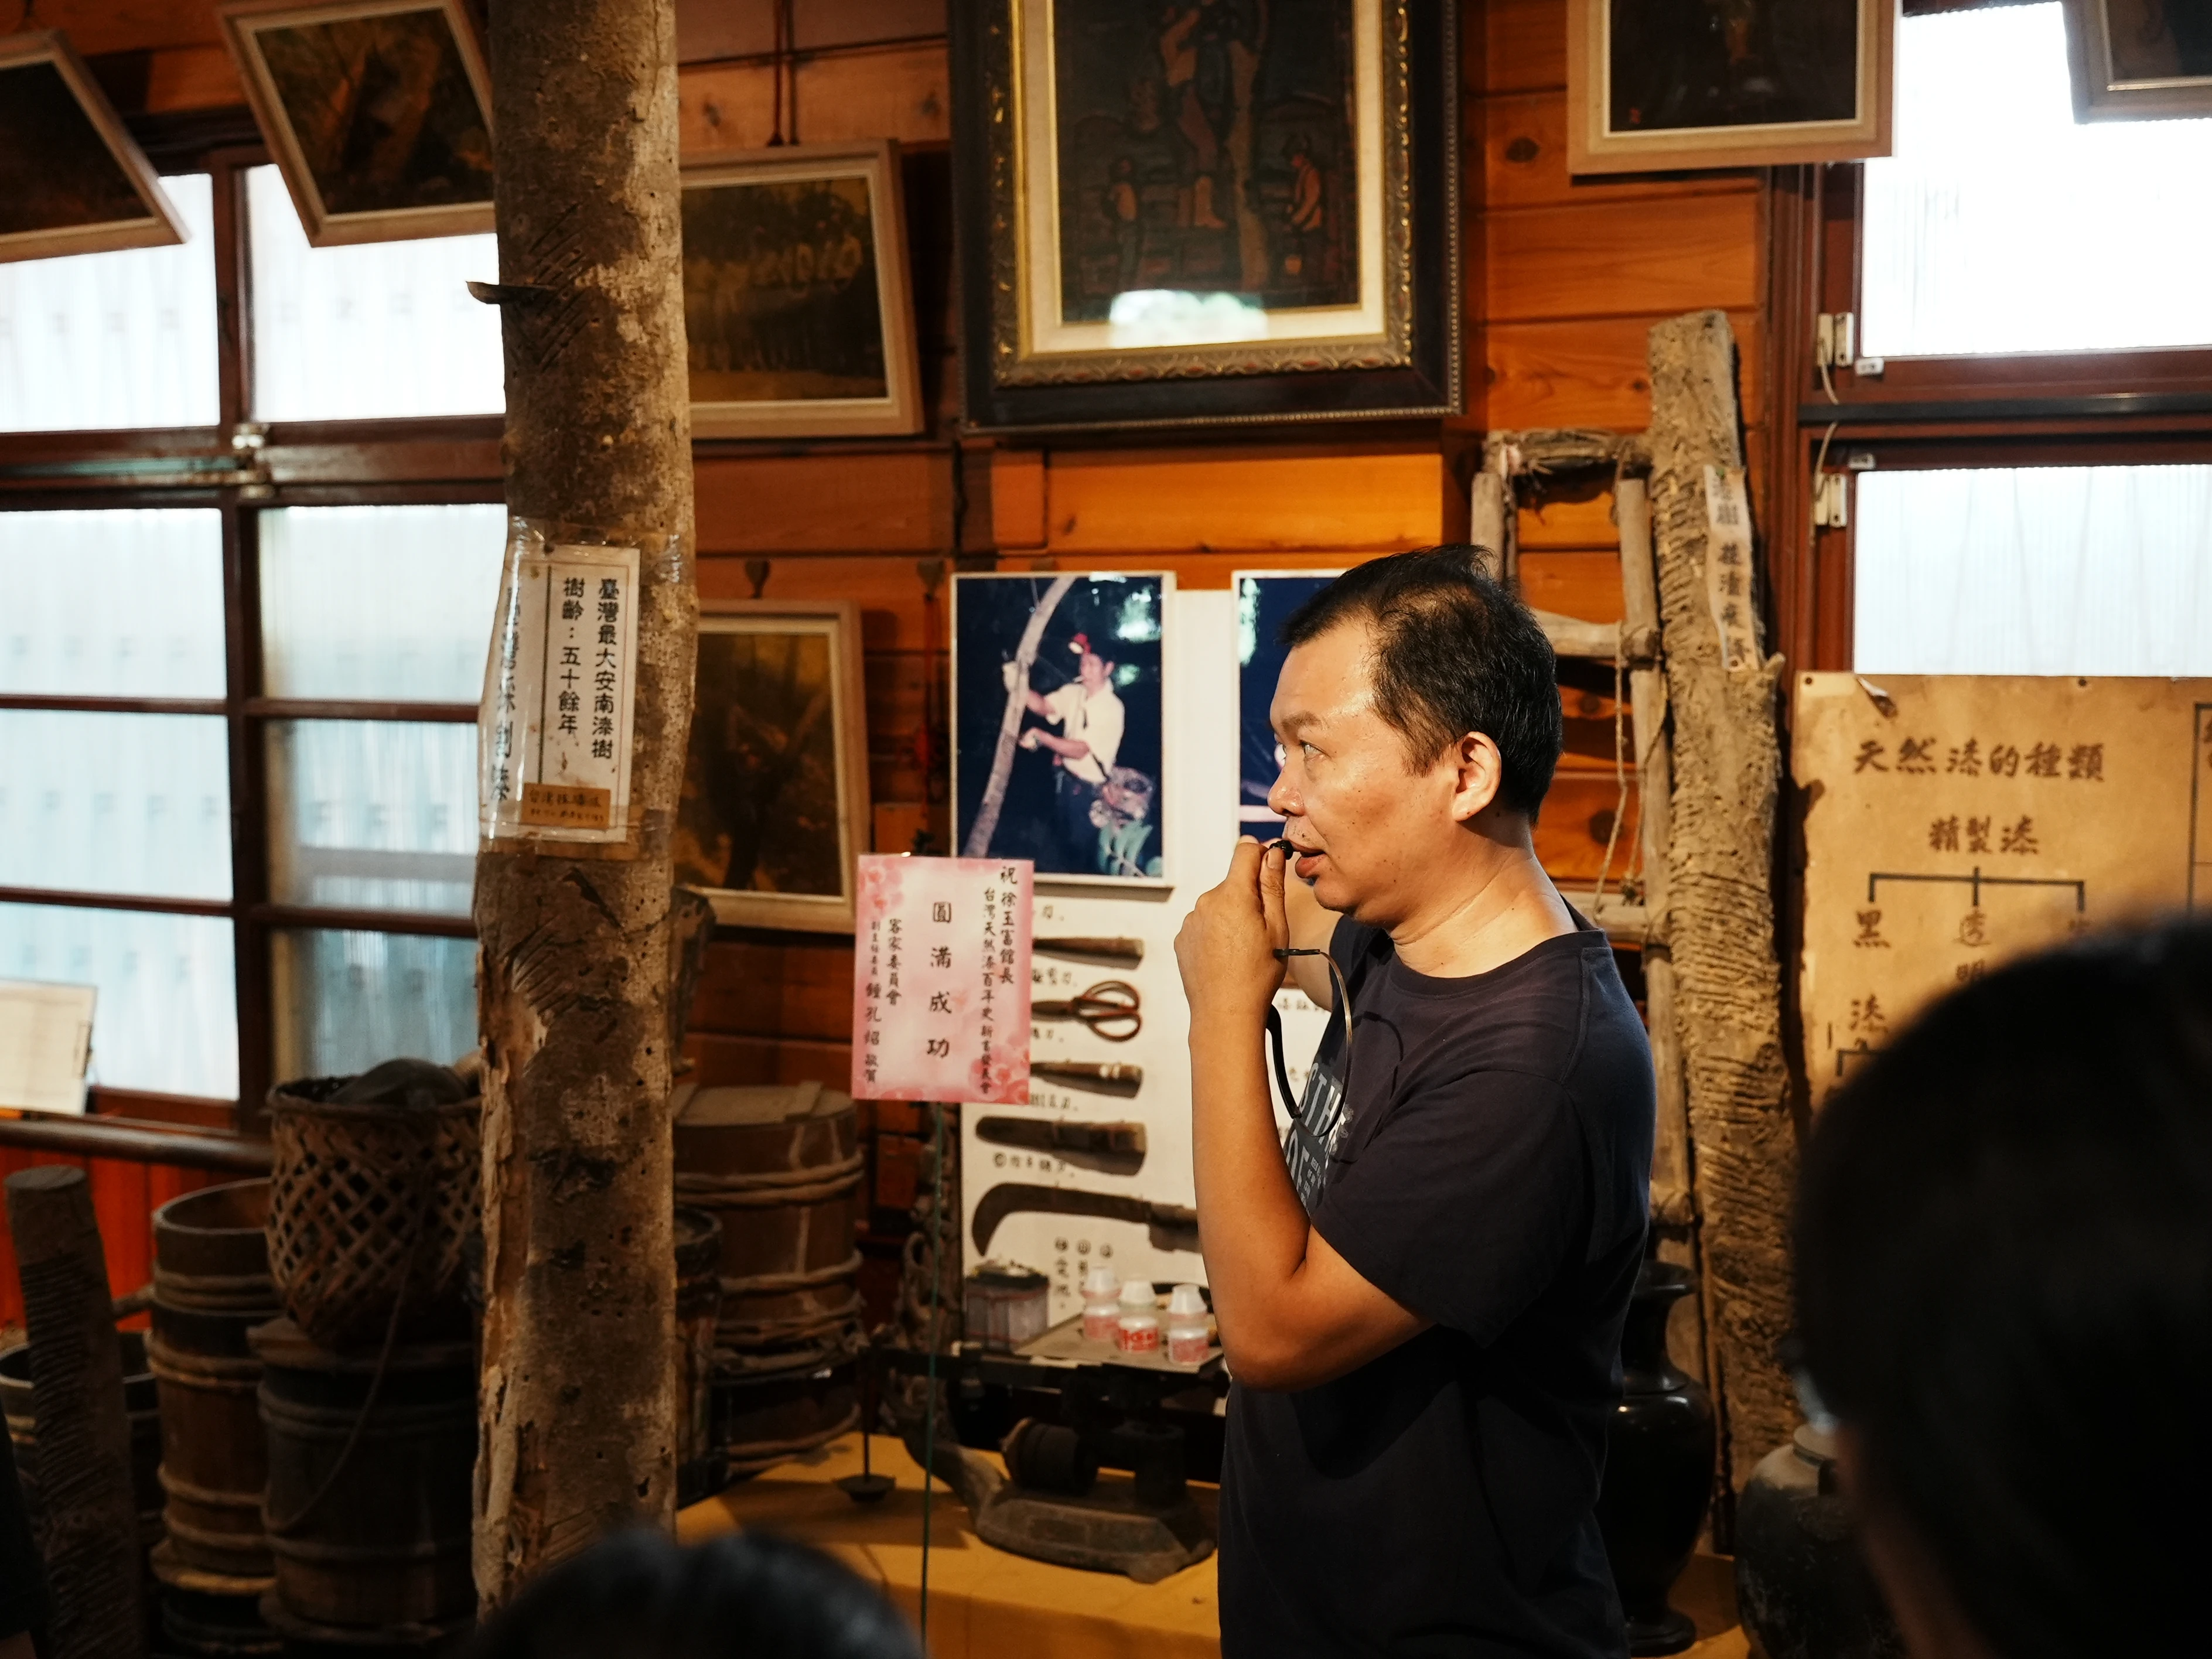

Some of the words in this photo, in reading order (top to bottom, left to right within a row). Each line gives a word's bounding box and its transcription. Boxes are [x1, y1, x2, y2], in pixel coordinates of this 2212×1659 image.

[1852, 736, 2105, 784] 天然漆的種類
